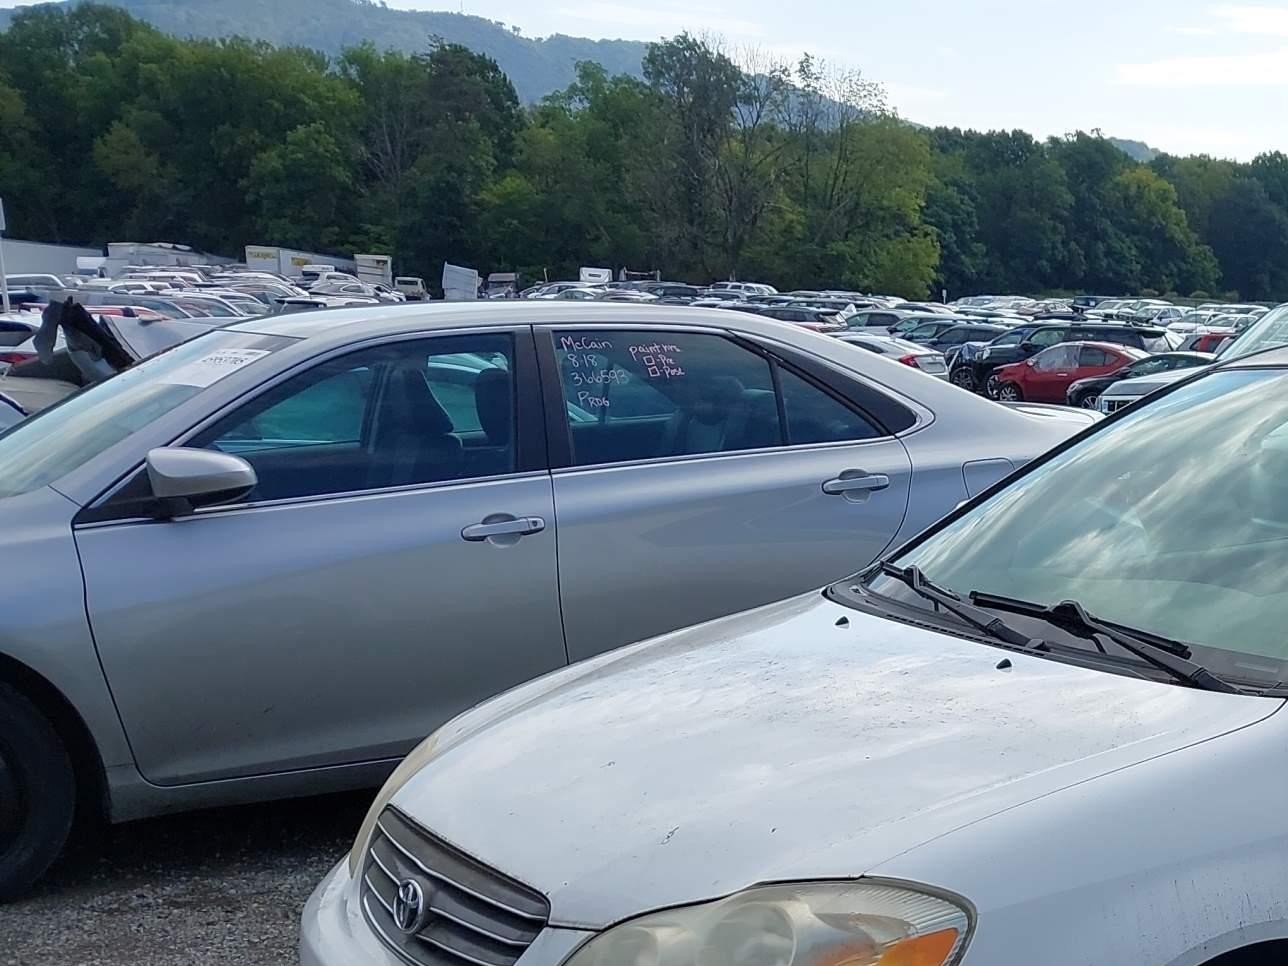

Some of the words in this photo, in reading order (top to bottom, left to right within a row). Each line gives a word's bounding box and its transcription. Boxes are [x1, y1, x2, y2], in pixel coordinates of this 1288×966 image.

[560, 336, 613, 351] McCain
[629, 342, 661, 361] paint
[570, 369, 631, 387] 366593
